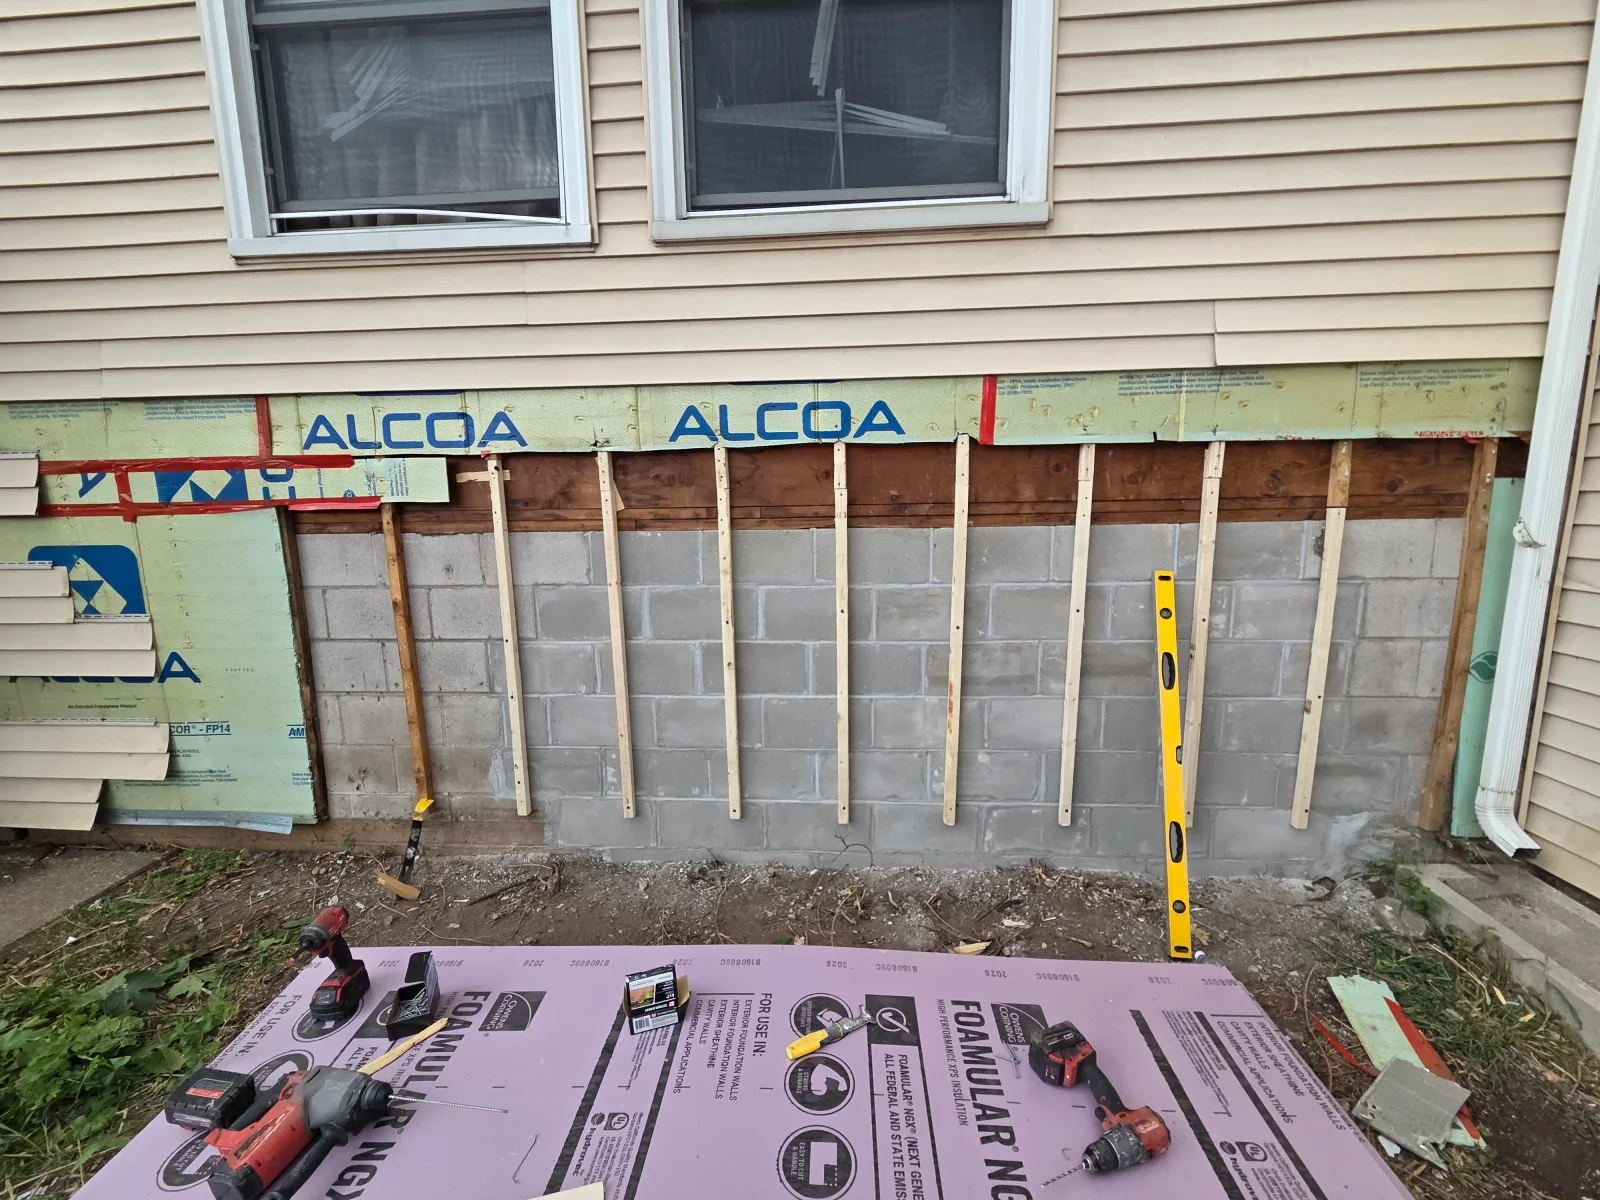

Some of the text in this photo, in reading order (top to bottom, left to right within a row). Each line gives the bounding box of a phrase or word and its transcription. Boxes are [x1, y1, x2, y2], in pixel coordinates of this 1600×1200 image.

[303, 412, 528, 450] ALCOA
[669, 400, 906, 442] ALCOA
[206, 723, 231, 734] FP14
[276, 995, 303, 1015] FOR
[486, 994, 518, 1030] OWENS CORNING
[699, 1000, 716, 1045] CAVITY WALLS
[1000, 1006, 1016, 1042] CORNING
[252, 1018, 282, 1039] USE
[706, 1000, 728, 1069] EXTERIOR SHEATHING
[752, 993, 772, 1056] FOR USE IN:
[1010, 1012, 1026, 1042] OWENS
[210, 1031, 250, 1069] FOUNDATIO
[235, 1042, 258, 1057] IN:
[348, 1047, 364, 1062] ALL
[672, 1000, 704, 1094] COMMERCIAL APPLICATIONS
[715, 1000, 741, 1100] INTERIOR FOUNDATION WALLS
[729, 1000, 753, 1101] EXTERIOR FOUNDATION WALLS
[936, 999, 968, 1126] HIGH PERFORMANCE XPS INSULATION
[1230, 1021, 1270, 1070] CAVITY WALLS
[1244, 1021, 1271, 1054] EXTERIOR
[1269, 1054, 1304, 1097] SHEATHING
[1217, 1021, 1251, 1065] COMMERCIAL
[1250, 1066, 1294, 1124] APPLICATIONS
[1257, 1021, 1285, 1052] INTERIOR
[1283, 1054, 1323, 1101] FOUNDATION
[1320, 1102, 1346, 1130] WALLS
[613, 1116, 626, 1126] UL
[884, 1053, 908, 1200] ALL FEDERAL AND STATE EMIS
[572, 1128, 597, 1176] hydrovac
[624, 1147, 634, 1163] Quality
[798, 1158, 804, 1167] TO
[904, 1136, 920, 1168] (NEXT
[1250, 1146, 1260, 1156] UL
[616, 1164, 628, 1188] Standards
